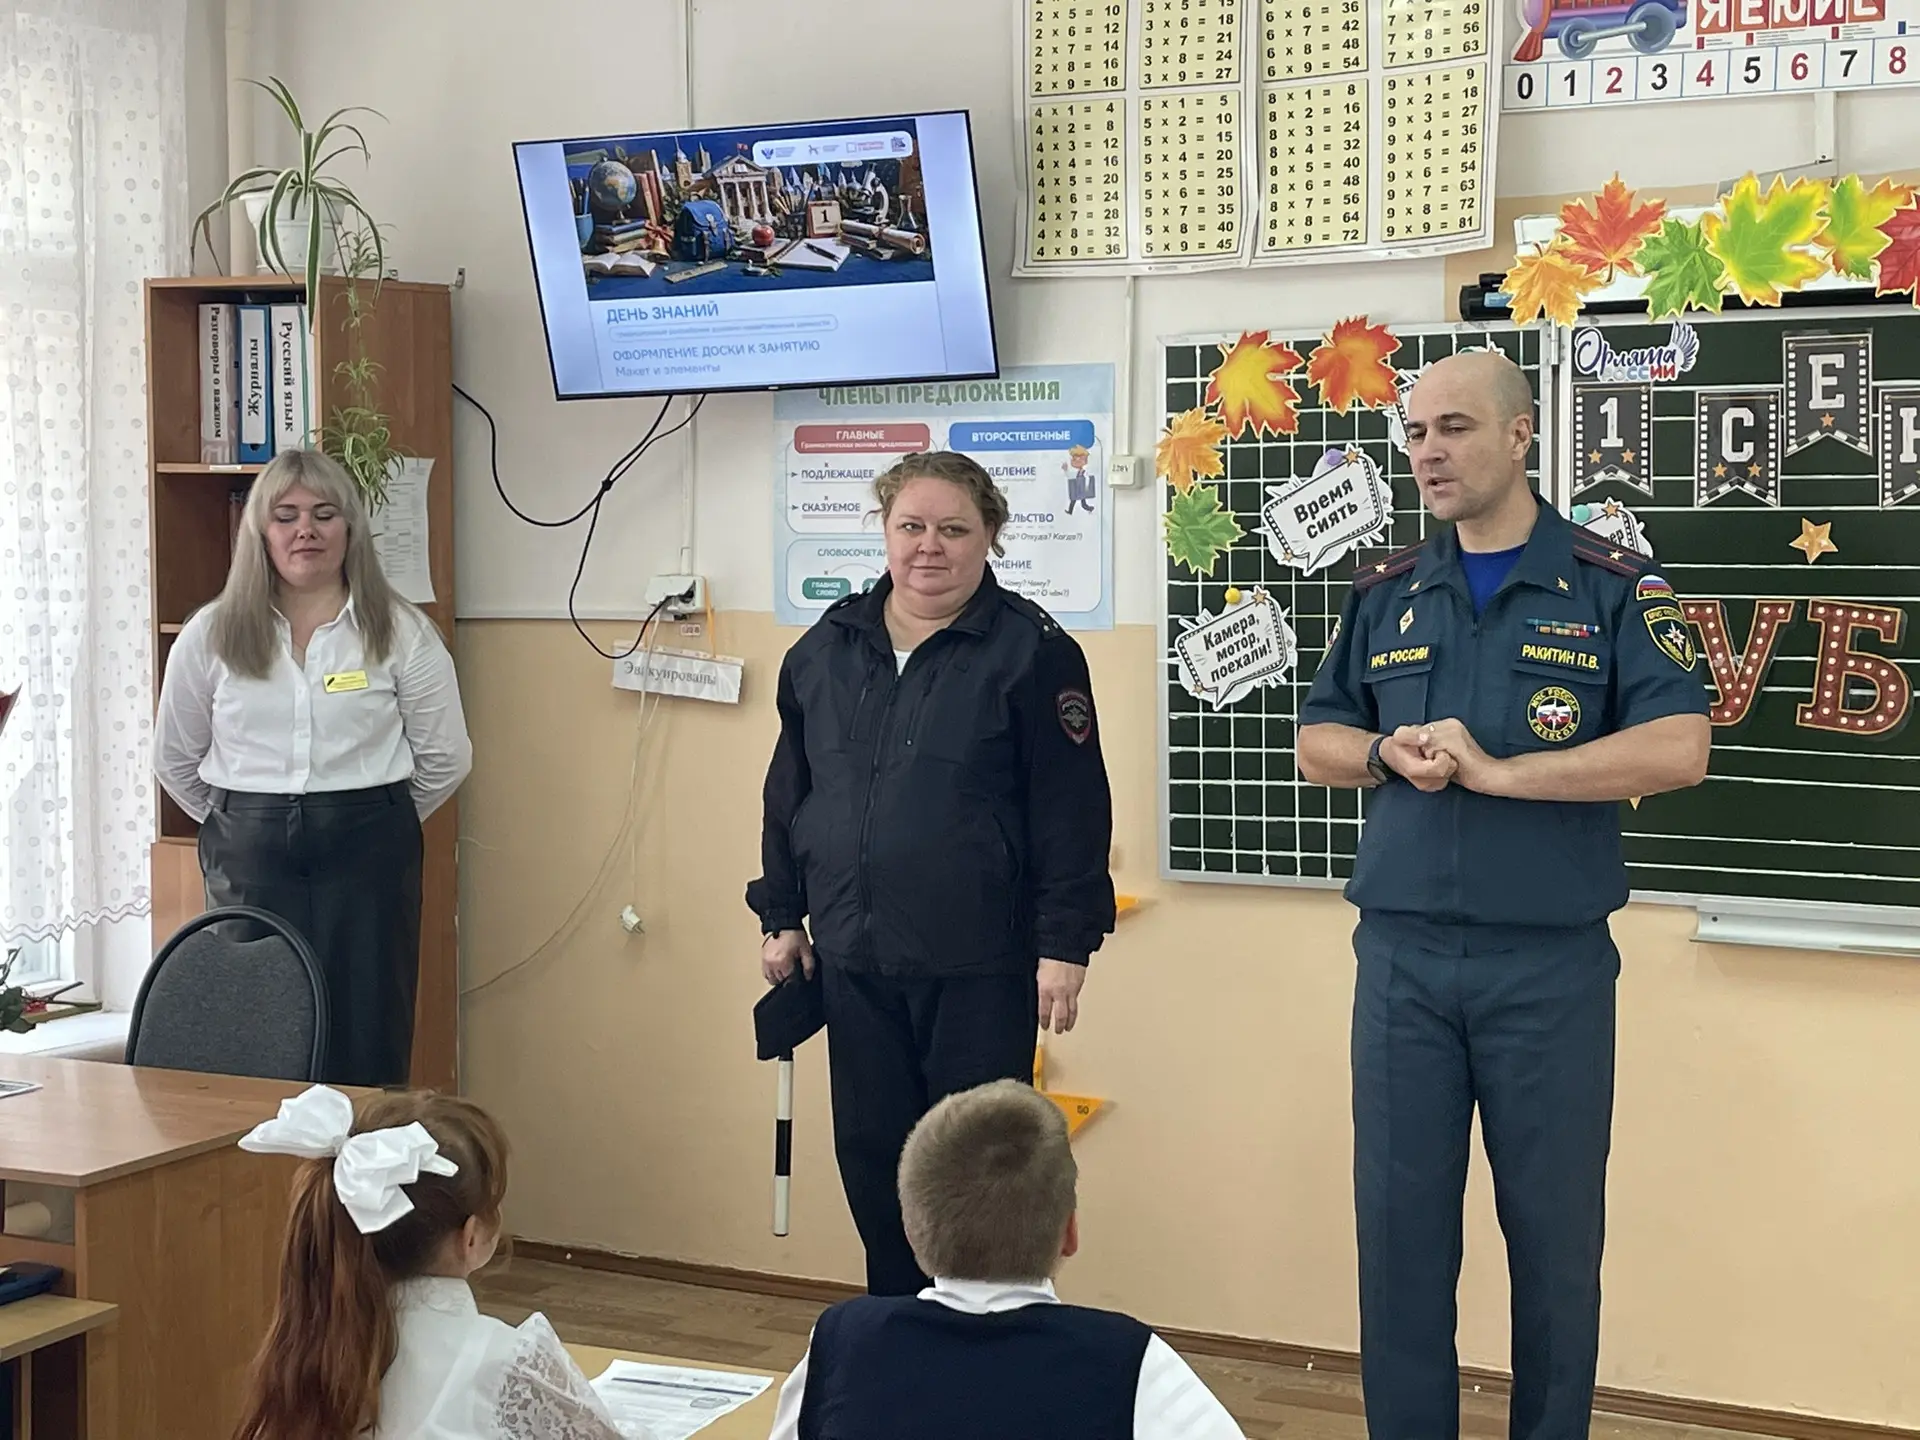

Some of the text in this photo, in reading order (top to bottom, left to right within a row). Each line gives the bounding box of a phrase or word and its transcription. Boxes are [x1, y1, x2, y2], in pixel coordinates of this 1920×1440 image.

[1035, 28, 1043, 40] 2
[1068, 26, 1076, 37] 6
[1104, 22, 1119, 34] 12
[1145, 20, 1153, 31] 3
[1180, 17, 1189, 28] 6
[1218, 13, 1234, 25] 18
[1266, 29, 1275, 41] 6
[1302, 25, 1311, 37] 7
[1342, 19, 1359, 32] 42
[1388, 33, 1396, 45] 7
[1424, 28, 1433, 40] 8
[1463, 21, 1480, 34] 56
[1387, 51, 1396, 63] 7
[1424, 47, 1433, 58] 9
[1463, 39, 1479, 53] 63
[1144, 73, 1152, 84] 3
[1178, 70, 1186, 82] 9
[1215, 67, 1232, 79] 27
[1517, 46, 1907, 99] 0 1 2 3 4 5 6 7 8
[1035, 81, 1042, 92] 2
[1067, 78, 1075, 90] 9
[1103, 76, 1118, 87] 18
[1268, 93, 1277, 104] 8
[1305, 89, 1311, 100] 1
[1347, 84, 1356, 96] 8
[1388, 97, 1396, 109] 9
[1424, 93, 1432, 105] 2
[1462, 86, 1478, 99] 18
[1035, 107, 1042, 118] 4
[1068, 105, 1074, 116] 1
[1106, 102, 1114, 113] 4
[1144, 118, 1152, 129] 5
[1178, 115, 1187, 127] 2
[1216, 112, 1232, 124] 10
[1387, 152, 1396, 164] 9
[1424, 148, 1432, 160] 5
[1460, 141, 1476, 154] 45
[1037, 177, 1045, 188] 4
[1069, 175, 1077, 187] 5
[1103, 173, 1119, 184] 20
[819, 209, 830, 223] 1
[1145, 207, 1152, 218] 5
[1179, 205, 1188, 216] 7
[1217, 203, 1234, 215] 35
[1386, 226, 1395, 237] 9
[1422, 222, 1431, 233] 9
[1459, 215, 1473, 229] 81
[1268, 236, 1276, 247] 8
[1304, 233, 1312, 244] 9
[1342, 229, 1359, 241] 72
[607, 300, 719, 324] ДЕНЬ ЗНАНИЙ
[209, 306, 221, 375] Разговоры
[613, 340, 820, 361] ОФОРМЛЕНИЕ ДОСКИ К ЗАНЯТИЮ
[1577, 329, 1677, 376] Орлята
[248, 338, 262, 417] Журналы
[279, 321, 293, 432] Русский язык
[616, 363, 720, 377] Макет и элементы
[818, 381, 1060, 406] ЧЛЕНЫ ПРЕДЛОЖЕНИЯ
[213, 389, 221, 438] важном
[1600, 397, 1624, 448] 1
[836, 430, 885, 440] ГЛАВНЫЕ
[971, 431, 1071, 443] ВТОРОСТЕПЕННЫЕ
[801, 469, 875, 480] ПОДЛЕЖАЩЕЕ
[801, 503, 861, 512] СКАЗУЕМОЕ
[1293, 477, 1354, 524] Время
[1306, 502, 1358, 537] сиять
[1203, 611, 1260, 651] Камера,
[1216, 631, 1261, 663] мотор,
[1389, 646, 1429, 664] РОССИИ
[1522, 644, 1600, 669] РАКИТИН П.В.
[1211, 638, 1273, 683] поехали!
